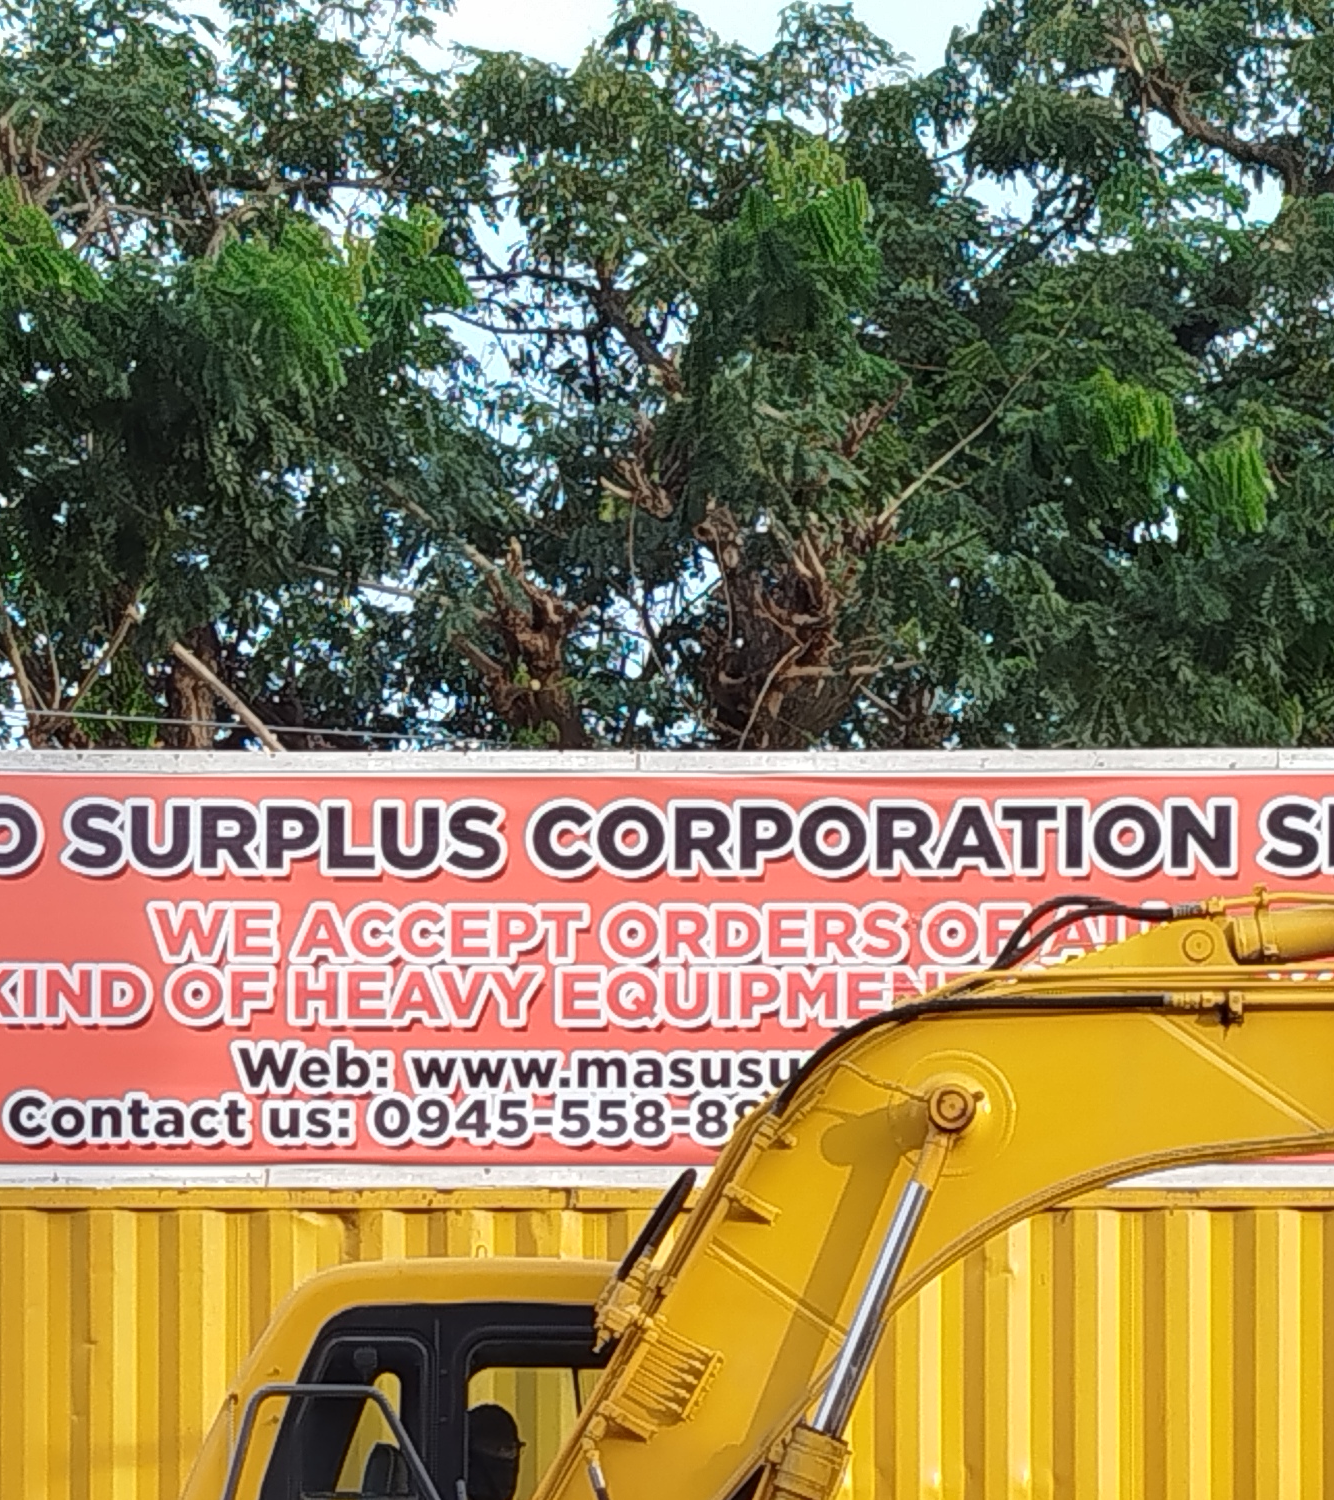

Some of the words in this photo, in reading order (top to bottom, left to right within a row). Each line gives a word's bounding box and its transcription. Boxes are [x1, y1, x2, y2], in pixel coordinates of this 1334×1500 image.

[65, 802, 504, 873] SURPLUS
[530, 802, 1235, 873] CORPORATION
[150, 904, 278, 959] WE
[294, 905, 588, 961] ACCEPT
[604, 906, 906, 961] ORDERS
[168, 967, 274, 1021] OF
[290, 968, 536, 1022] HEAVY
[236, 1045, 391, 1091] Web:
[6, 1094, 247, 1141] Contact
[268, 1100, 352, 1141] us:
[372, 1097, 764, 1142] 0945-558-8
